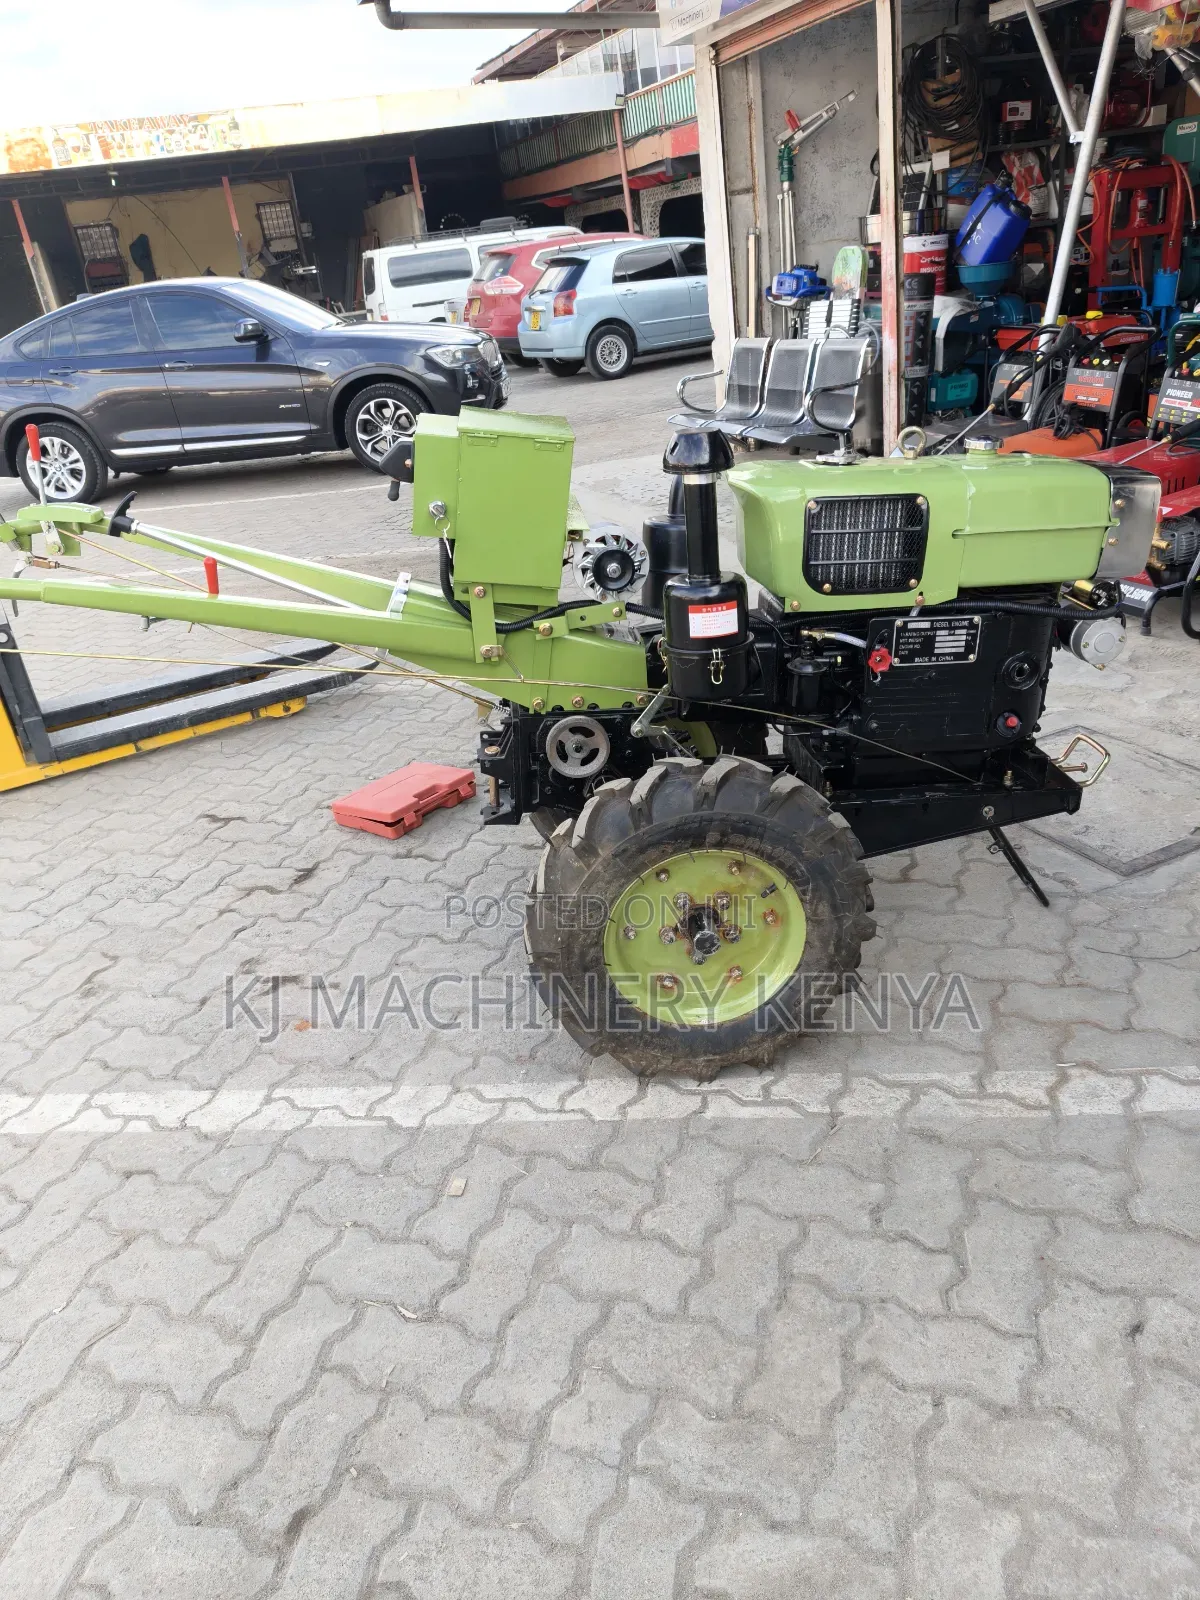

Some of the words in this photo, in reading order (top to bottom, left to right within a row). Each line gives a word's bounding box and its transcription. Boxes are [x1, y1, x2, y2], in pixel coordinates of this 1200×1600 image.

[89, 118, 139, 134] TAKE
[141, 114, 190, 131] AWAY
[1166, 389, 1193, 399] PIONEER
